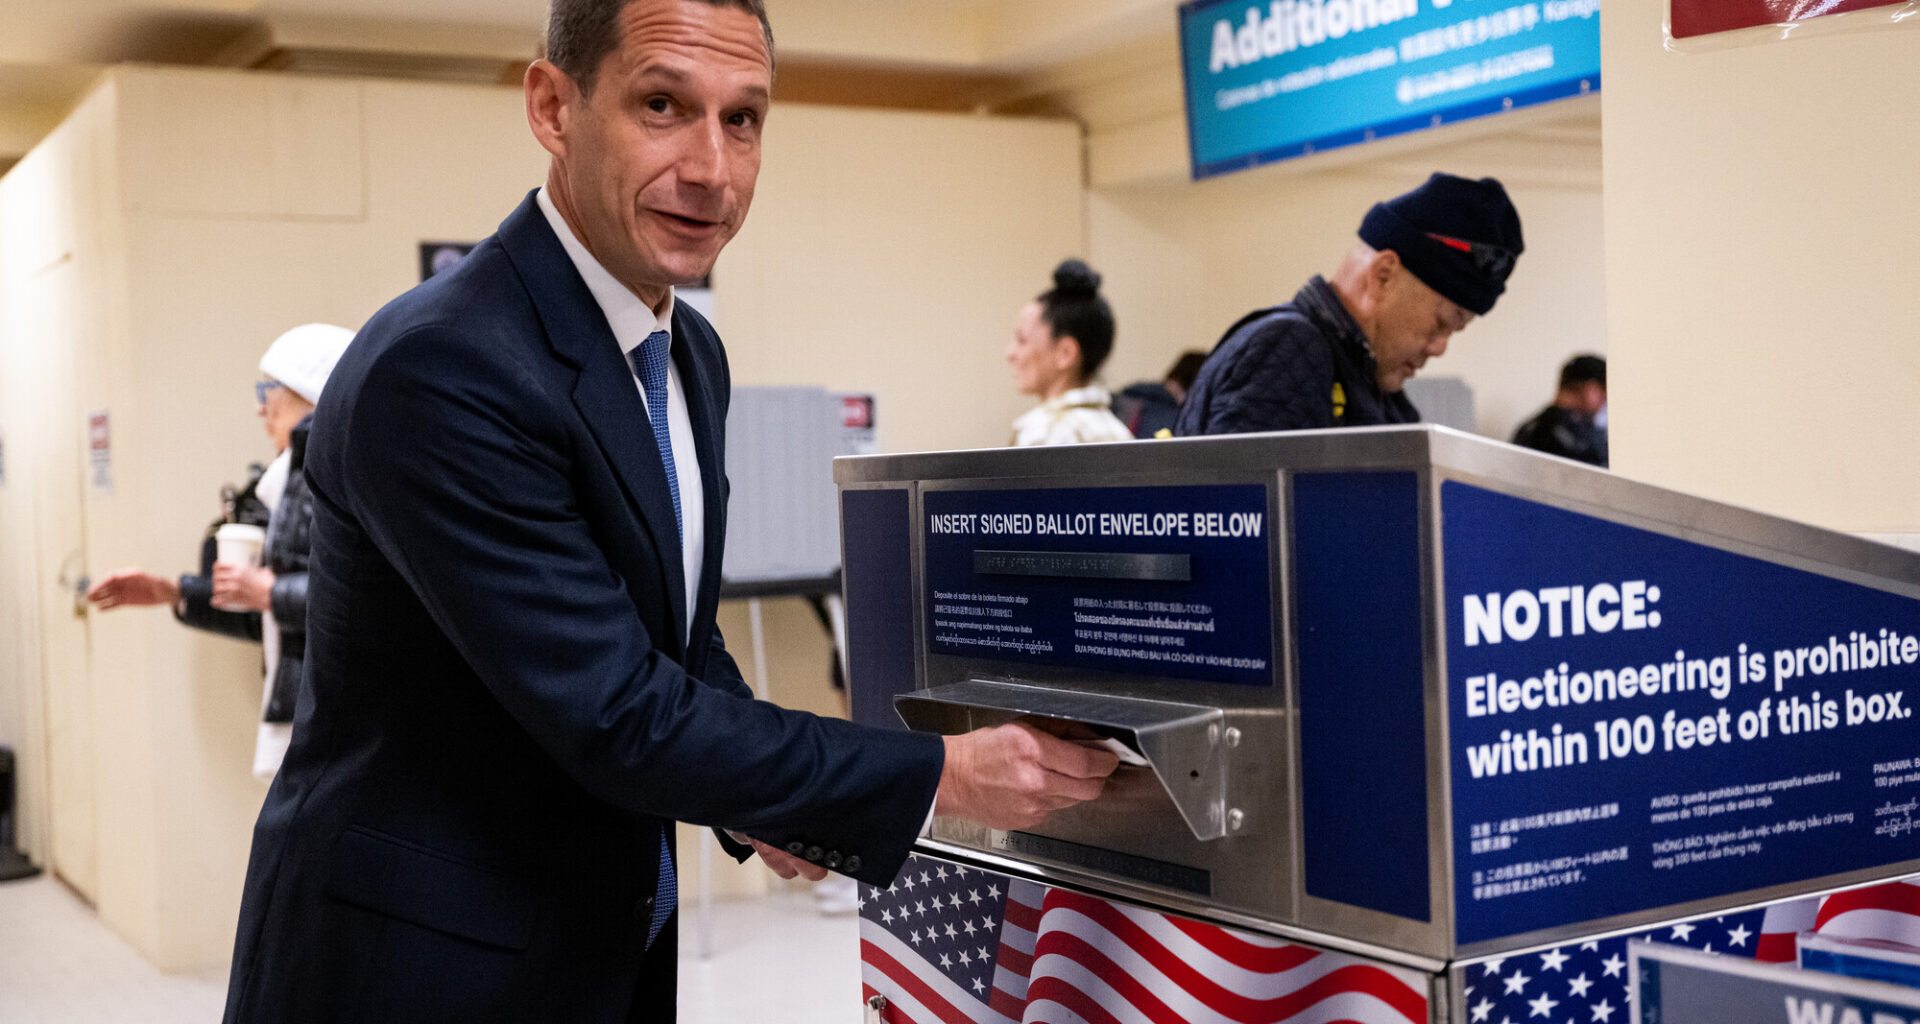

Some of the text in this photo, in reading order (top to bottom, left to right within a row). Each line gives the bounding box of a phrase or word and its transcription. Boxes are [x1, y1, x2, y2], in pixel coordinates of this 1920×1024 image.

[931, 512, 1262, 537] INSERT SIGNED BALLOT ENVELOPE BELOW
[958, 592, 970, 600] sobre
[983, 594, 997, 602] boleta
[998, 594, 1014, 602] firmado
[1015, 595, 1028, 605] abajo
[1463, 580, 1661, 646] NOTICE:
[1001, 624, 1014, 632] balota
[1087, 646, 1106, 655] PHONG
[1465, 627, 1920, 718] Electioneering is prohibite
[1467, 689, 1912, 778] within 100 feet of this box.
[1682, 792, 1707, 806] queda
[1708, 787, 1744, 802] prohibido
[1744, 783, 1766, 794] hacer
[1768, 777, 1802, 791] campaña
[1803, 771, 1834, 785] electoral
[1874, 776, 1888, 787] 100
[1651, 811, 1679, 824] menos
[1680, 808, 1691, 819] de
[1692, 805, 1707, 816] 100
[1708, 804, 1725, 817] pies
[1726, 802, 1737, 812] de
[1834, 812, 1854, 824] trong
[1691, 851, 1706, 862] feet
